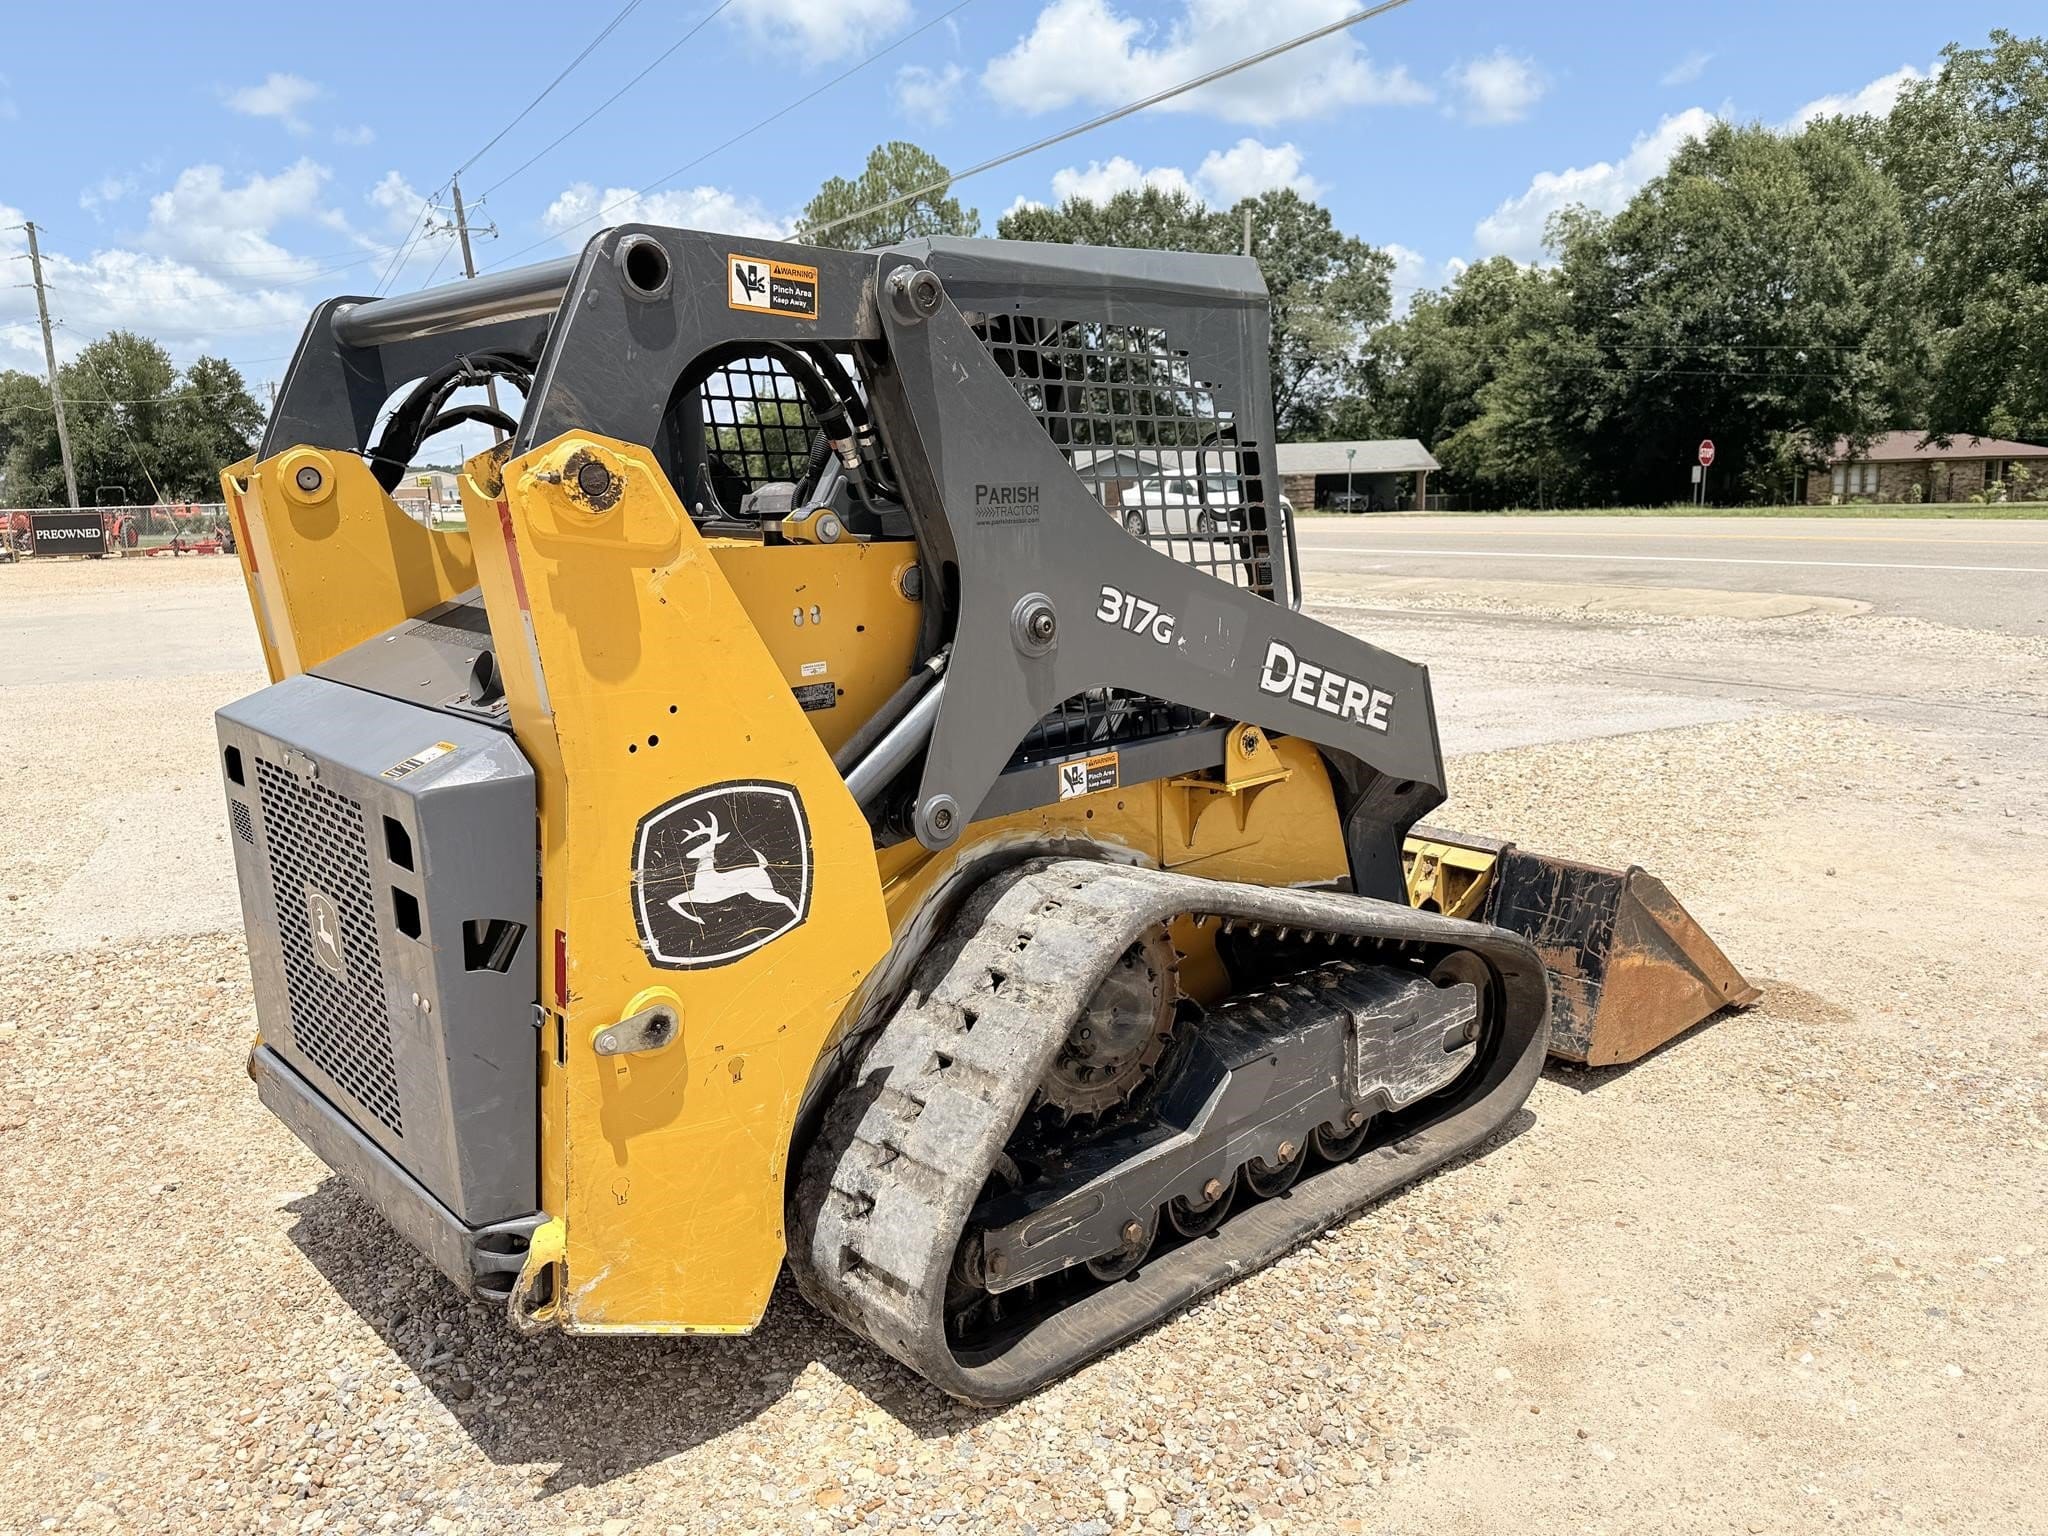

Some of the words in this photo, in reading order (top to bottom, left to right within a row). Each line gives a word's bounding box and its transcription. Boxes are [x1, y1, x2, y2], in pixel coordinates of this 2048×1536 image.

[780, 268, 814, 279] WARNING
[773, 284, 794, 295] Pinch
[795, 287, 812, 298] Area
[772, 295, 789, 306] Keep
[790, 298, 807, 308] Away
[1700, 447, 1713, 458] STOP
[975, 484, 1039, 505] PARISH
[995, 505, 1040, 517] TRACTOR
[35, 528, 101, 540] PREOWNED
[1097, 586, 1175, 644] 317G
[1260, 641, 1395, 732] DEERE
[1088, 772, 1103, 780] Pinch
